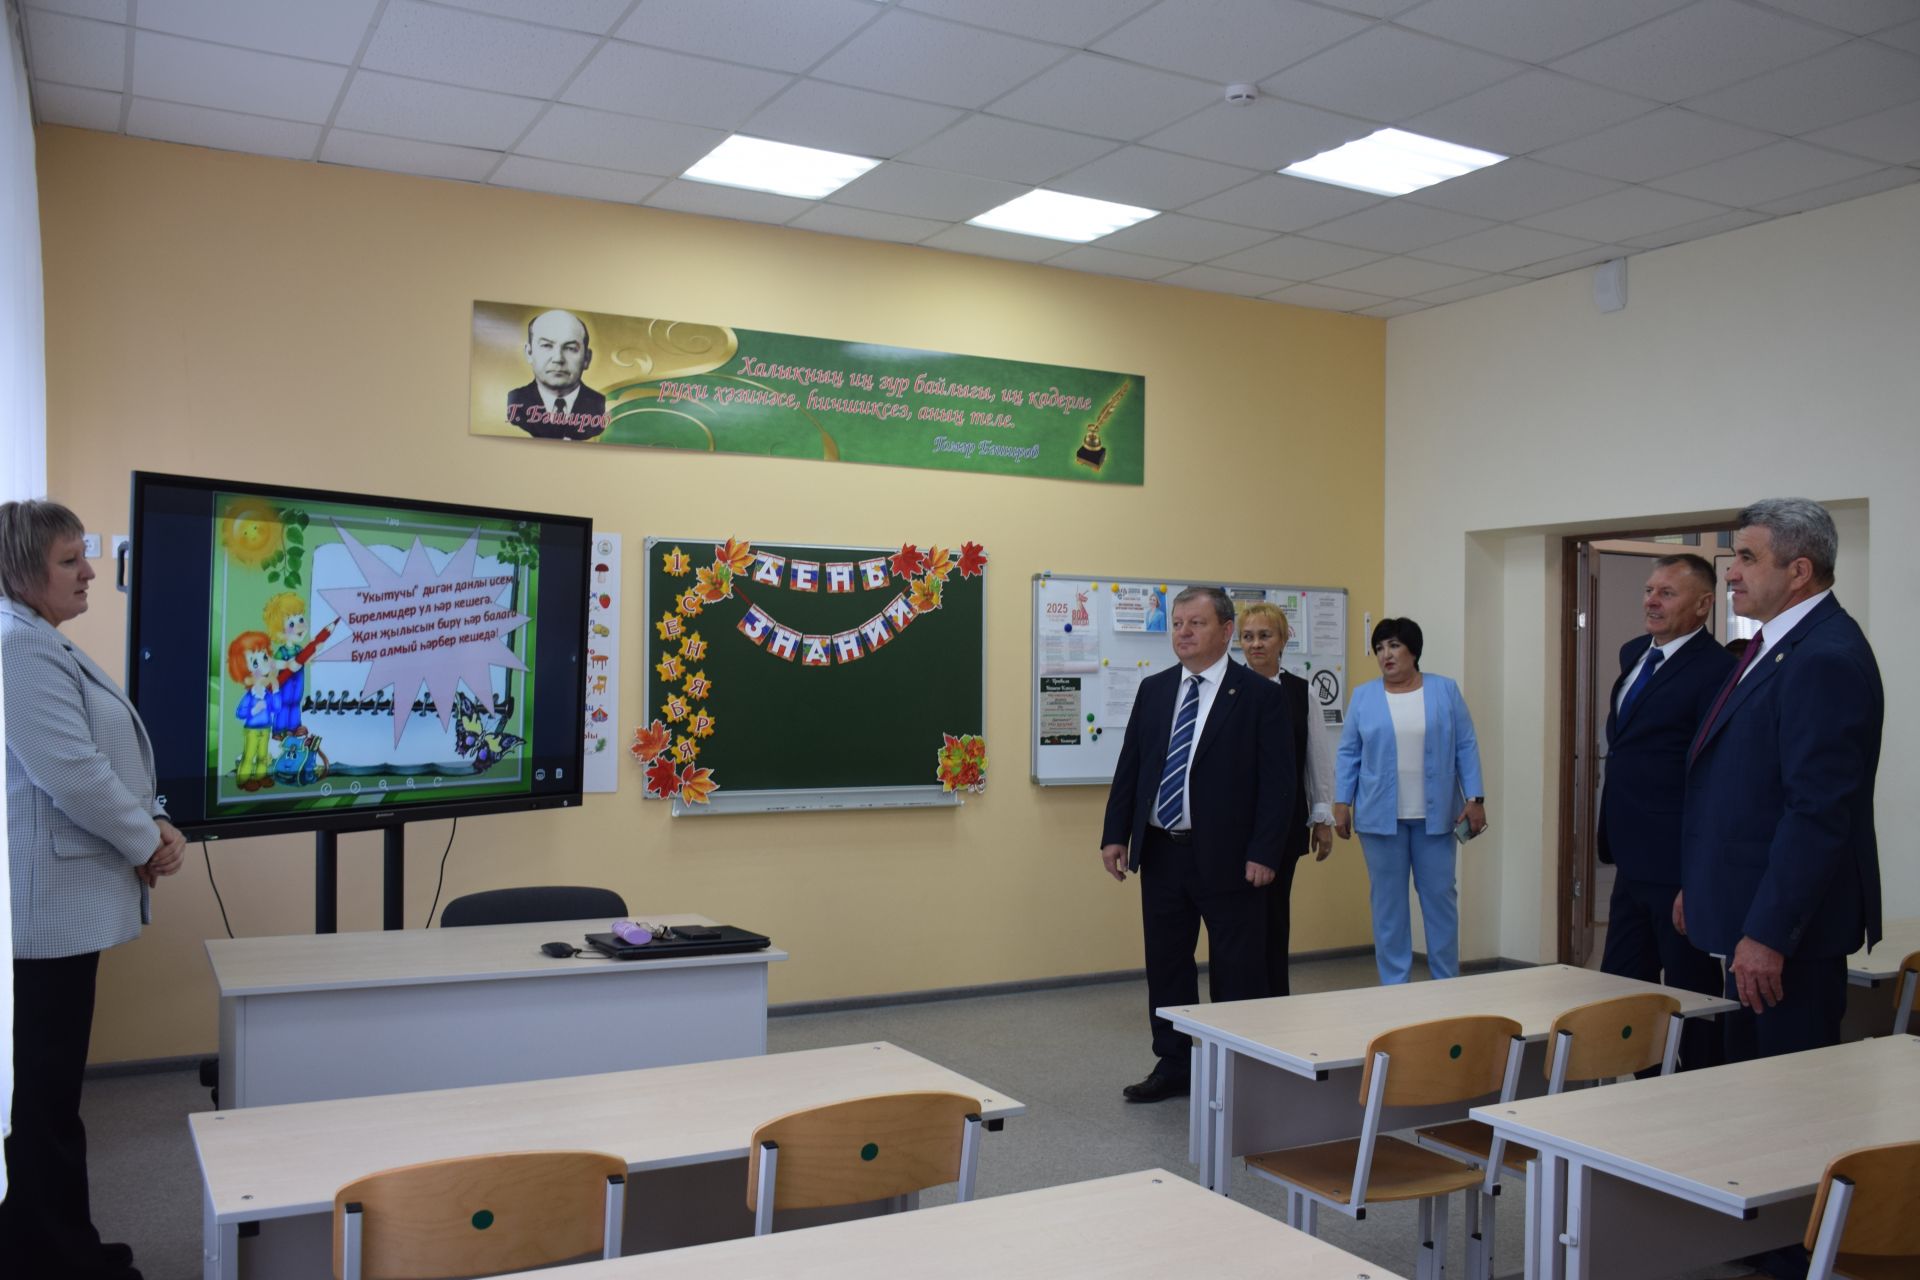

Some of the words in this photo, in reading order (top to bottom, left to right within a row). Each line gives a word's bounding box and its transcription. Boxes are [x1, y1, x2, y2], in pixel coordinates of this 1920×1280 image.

[737, 356, 844, 388] Халыкның
[849, 375, 874, 391] иң
[879, 375, 909, 398] зур
[913, 373, 996, 403] байлыгы,
[1001, 388, 1024, 407] иң
[1028, 386, 1092, 415] кадерле
[505, 403, 523, 423] Г.
[657, 380, 709, 404] рухи
[917, 406, 965, 426] аның
[970, 411, 1016, 429] теле.
[672, 552, 682, 572] 1
[755, 556, 886, 592] ДЕНЬ
[422, 583, 453, 598] дигән
[454, 579, 488, 592] данлы
[490, 575, 514, 587] исем
[349, 605, 417, 625] Бирелмидер
[419, 602, 432, 616] ул
[434, 599, 452, 613] һәр
[454, 595, 493, 608] кешегә.
[1046, 602, 1068, 614] 2025
[352, 630, 378, 643] Җан
[380, 623, 435, 640] җылысын
[437, 618, 461, 632] бирү
[464, 614, 481, 627] һәр
[483, 609, 517, 622] балага
[351, 648, 377, 663] Була
[380, 643, 417, 658] алмый
[420, 635, 456, 652] һәрбер
[458, 628, 499, 645] кешедә!
